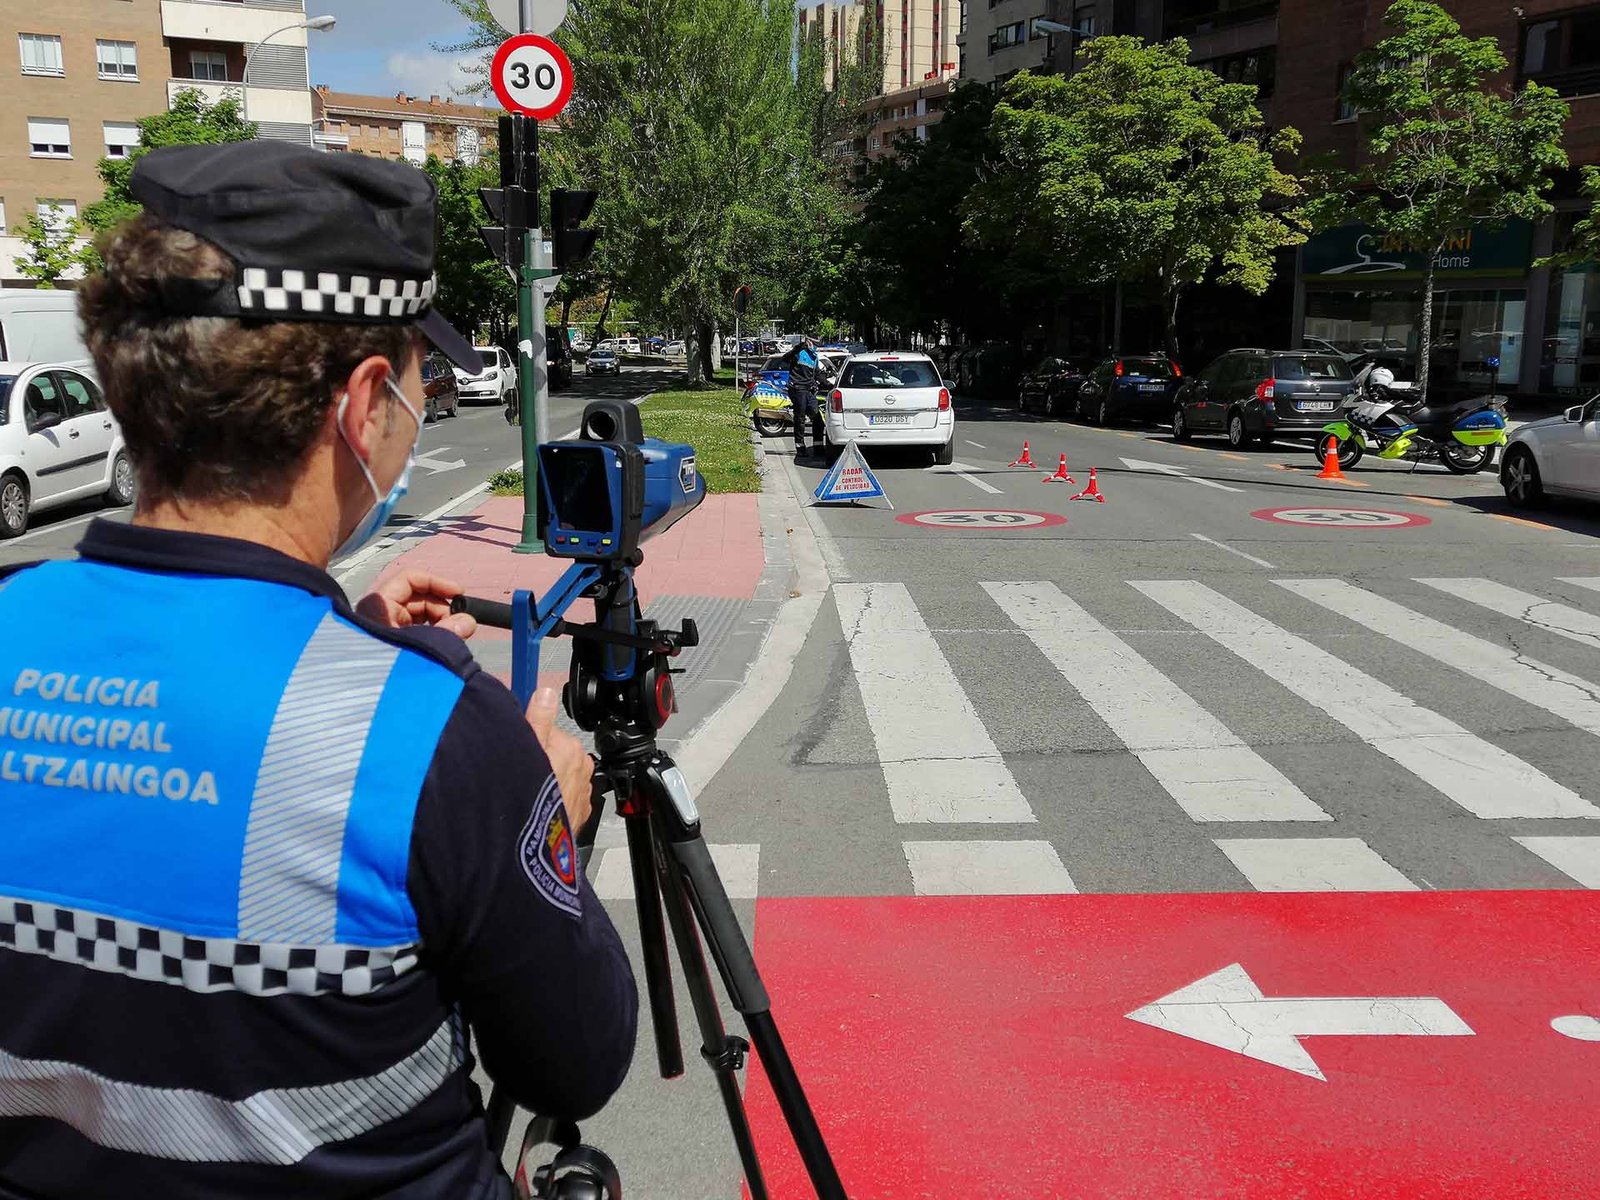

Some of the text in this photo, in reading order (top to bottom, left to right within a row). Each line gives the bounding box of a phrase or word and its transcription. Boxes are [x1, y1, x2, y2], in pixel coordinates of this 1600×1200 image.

[510, 61, 556, 91] 30
[1432, 254, 1471, 268] Home
[874, 415, 893, 423] 0320
[931, 514, 1026, 524] 30
[1286, 512, 1391, 523] 30
[14, 668, 160, 708] POLICIA
[1, 750, 219, 806] LTZAINGOA
[528, 855, 556, 895] POLICIA
